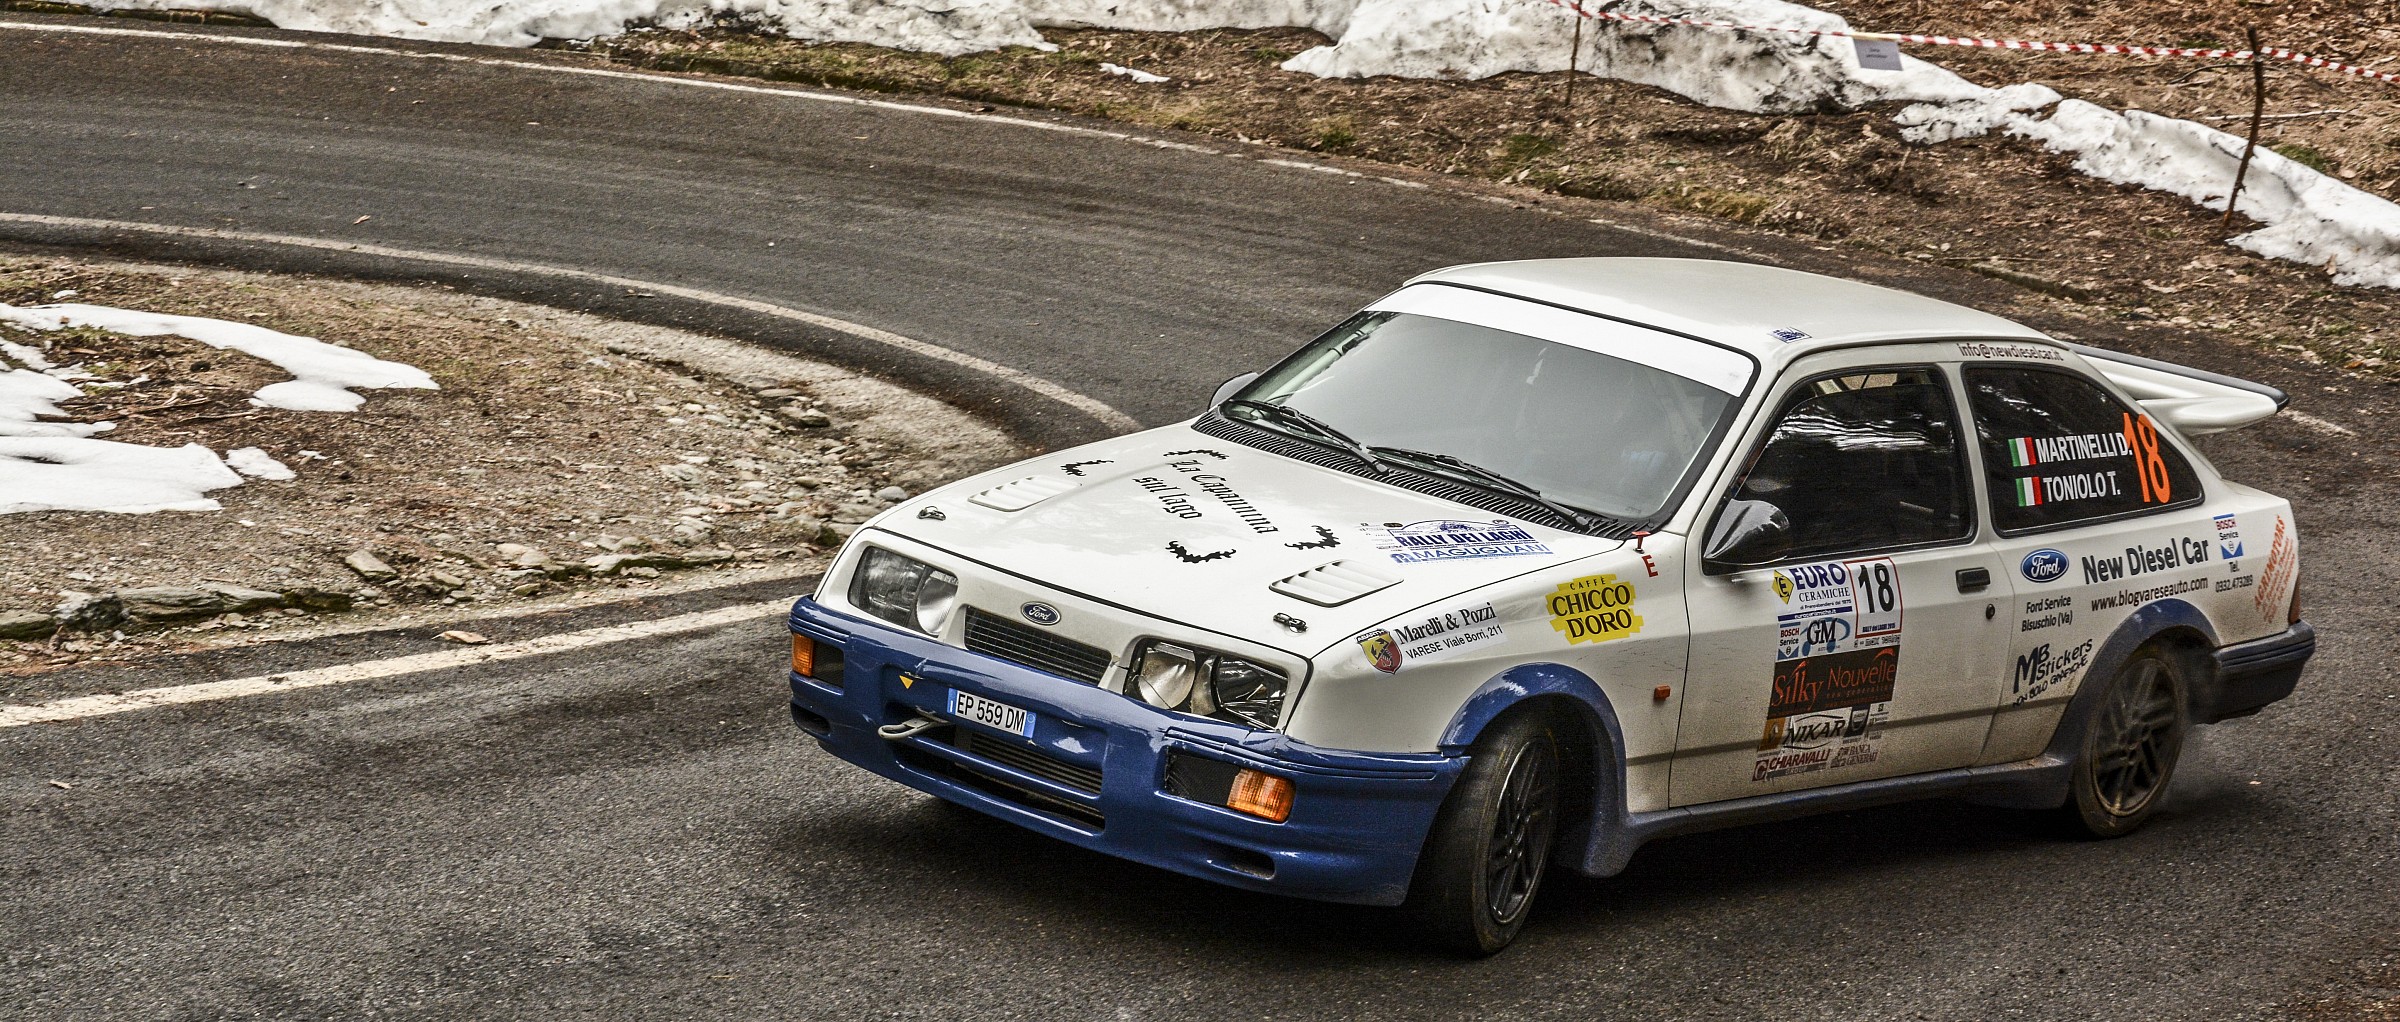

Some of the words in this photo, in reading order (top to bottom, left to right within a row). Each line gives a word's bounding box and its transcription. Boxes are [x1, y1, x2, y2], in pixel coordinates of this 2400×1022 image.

[2035, 433, 2118, 463] MARTINELLI
[2115, 432, 2133, 456] D.
[2123, 412, 2170, 504] 18
[1132, 477, 1181, 492] sul
[1158, 493, 1202, 519] lago
[2043, 472, 2107, 502] TONIOLO
[2106, 471, 2121, 496] T.
[2215, 519, 2236, 531] BOSCH
[2219, 531, 2239, 541] Service
[1394, 534, 1448, 547] RALLY
[1447, 532, 1482, 544] DEI
[1478, 530, 1534, 542] LAGHI
[1412, 544, 1550, 558] MAGUGLIANI
[1642, 554, 1658, 577] E
[2030, 554, 2060, 578] Ford
[2081, 555, 2124, 585] New
[2126, 537, 2181, 576] Diesel
[2182, 536, 2209, 565] Car
[1569, 576, 1606, 590] CAFFÈ
[1789, 564, 1846, 590] EURO
[1858, 563, 1894, 613] 18
[1552, 585, 1631, 616] CHICCO
[1798, 587, 1850, 602] CERAMICHE
[2026, 599, 2044, 614] Ford
[2044, 595, 2071, 611] Service
[2091, 577, 2209, 612] www.blogvareseauto.com
[1028, 605, 1051, 621] Ford
[1394, 616, 1446, 645] Marelli
[1445, 613, 1460, 631] &
[1459, 602, 1497, 626] Pozzi
[1566, 608, 1632, 638] D'ORO
[2021, 614, 2057, 632] Bisuschio
[2057, 610, 2073, 627] (Va)
[1405, 641, 1443, 659] VARESE
[1443, 635, 1465, 649] Viale
[1466, 628, 1490, 645] Borri,
[1488, 624, 1504, 637] 211
[1779, 637, 1799, 647] Service
[1780, 627, 1800, 638] BOSCH
[1807, 618, 1838, 645] GM
[2036, 638, 2093, 681] Stickers
[1828, 660, 1896, 690] Nouvelle
[957, 693, 974, 716] EP
[976, 699, 1003, 725] 559
[1005, 711, 1026, 732] DM
[1782, 720, 1847, 745] NIKAR
[1768, 748, 1833, 770] CHIARAVALLI
